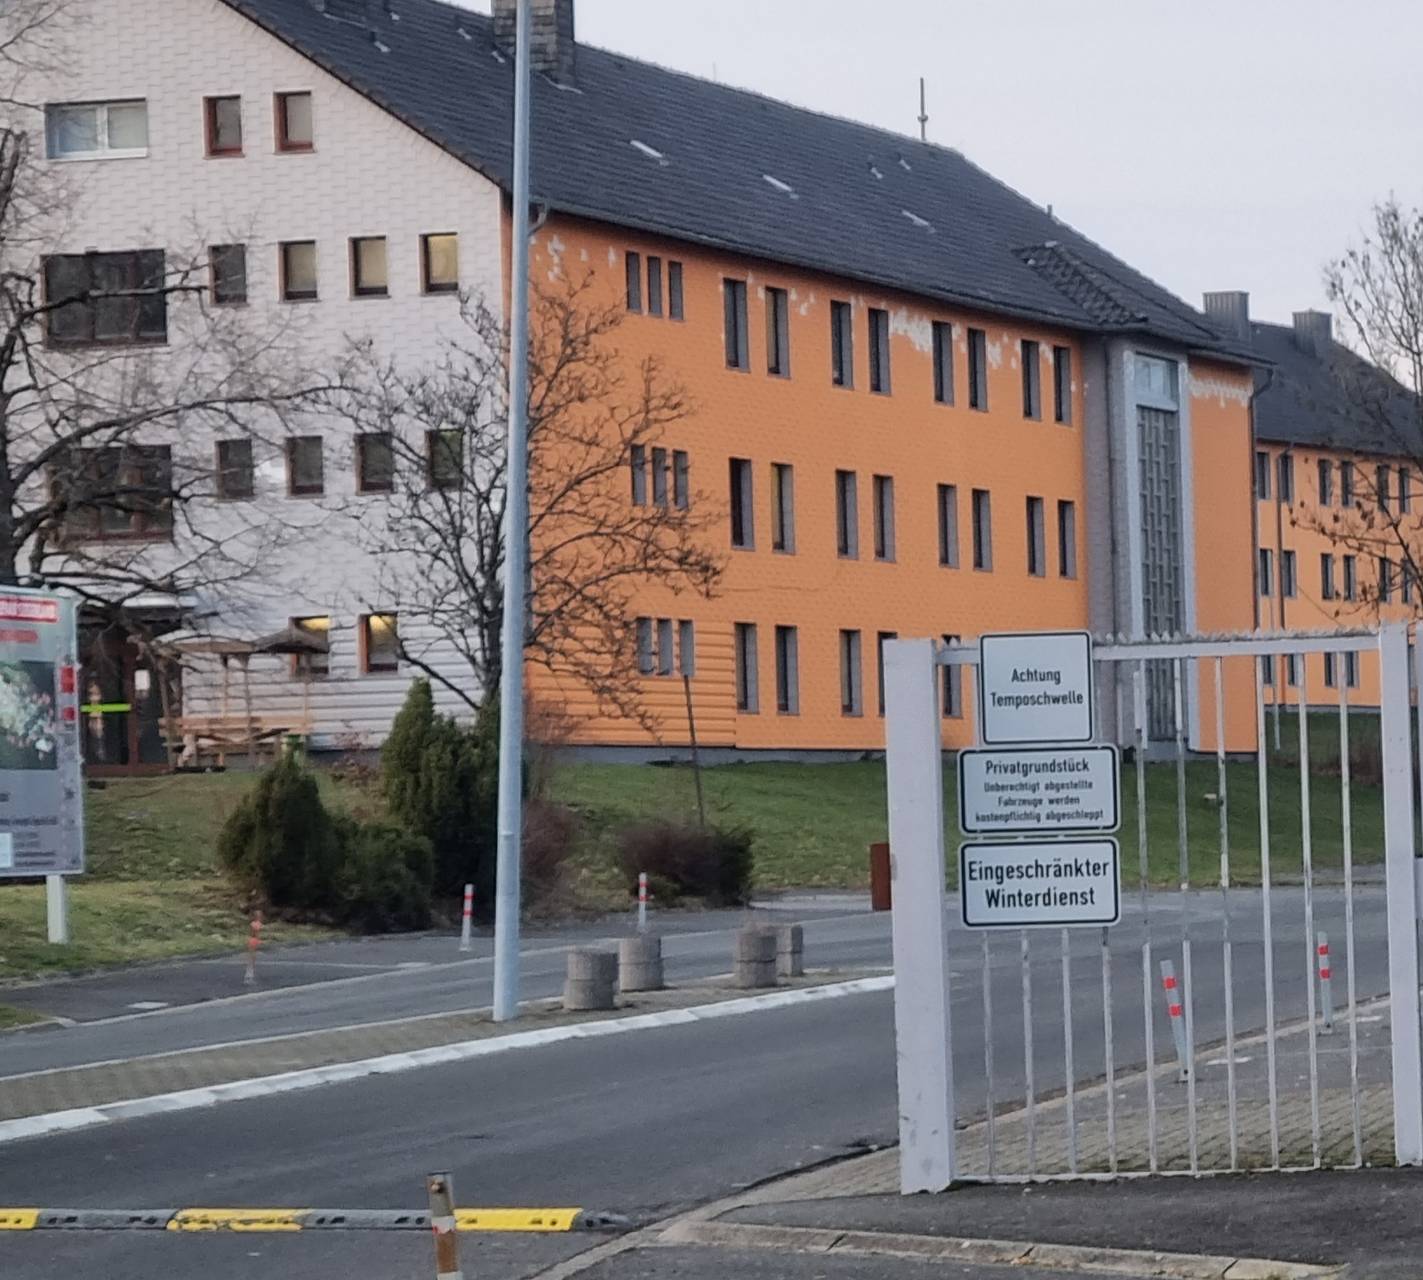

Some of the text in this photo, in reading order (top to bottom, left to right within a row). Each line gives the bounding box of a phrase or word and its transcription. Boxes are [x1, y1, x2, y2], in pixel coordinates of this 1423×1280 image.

[1011, 668, 1061, 685] Achtung
[990, 690, 1084, 709] Temposchwelle
[985, 758, 1090, 777] Privatgrundstück
[983, 780, 1093, 793] Unberechtigt abgestellte
[998, 796, 1080, 808] Fahrzeuge werden
[976, 809, 1103, 823] kostenpflichtig abgeschleppt
[968, 858, 1109, 884] Eingeschränkter
[985, 886, 1096, 908] Winterdienst
